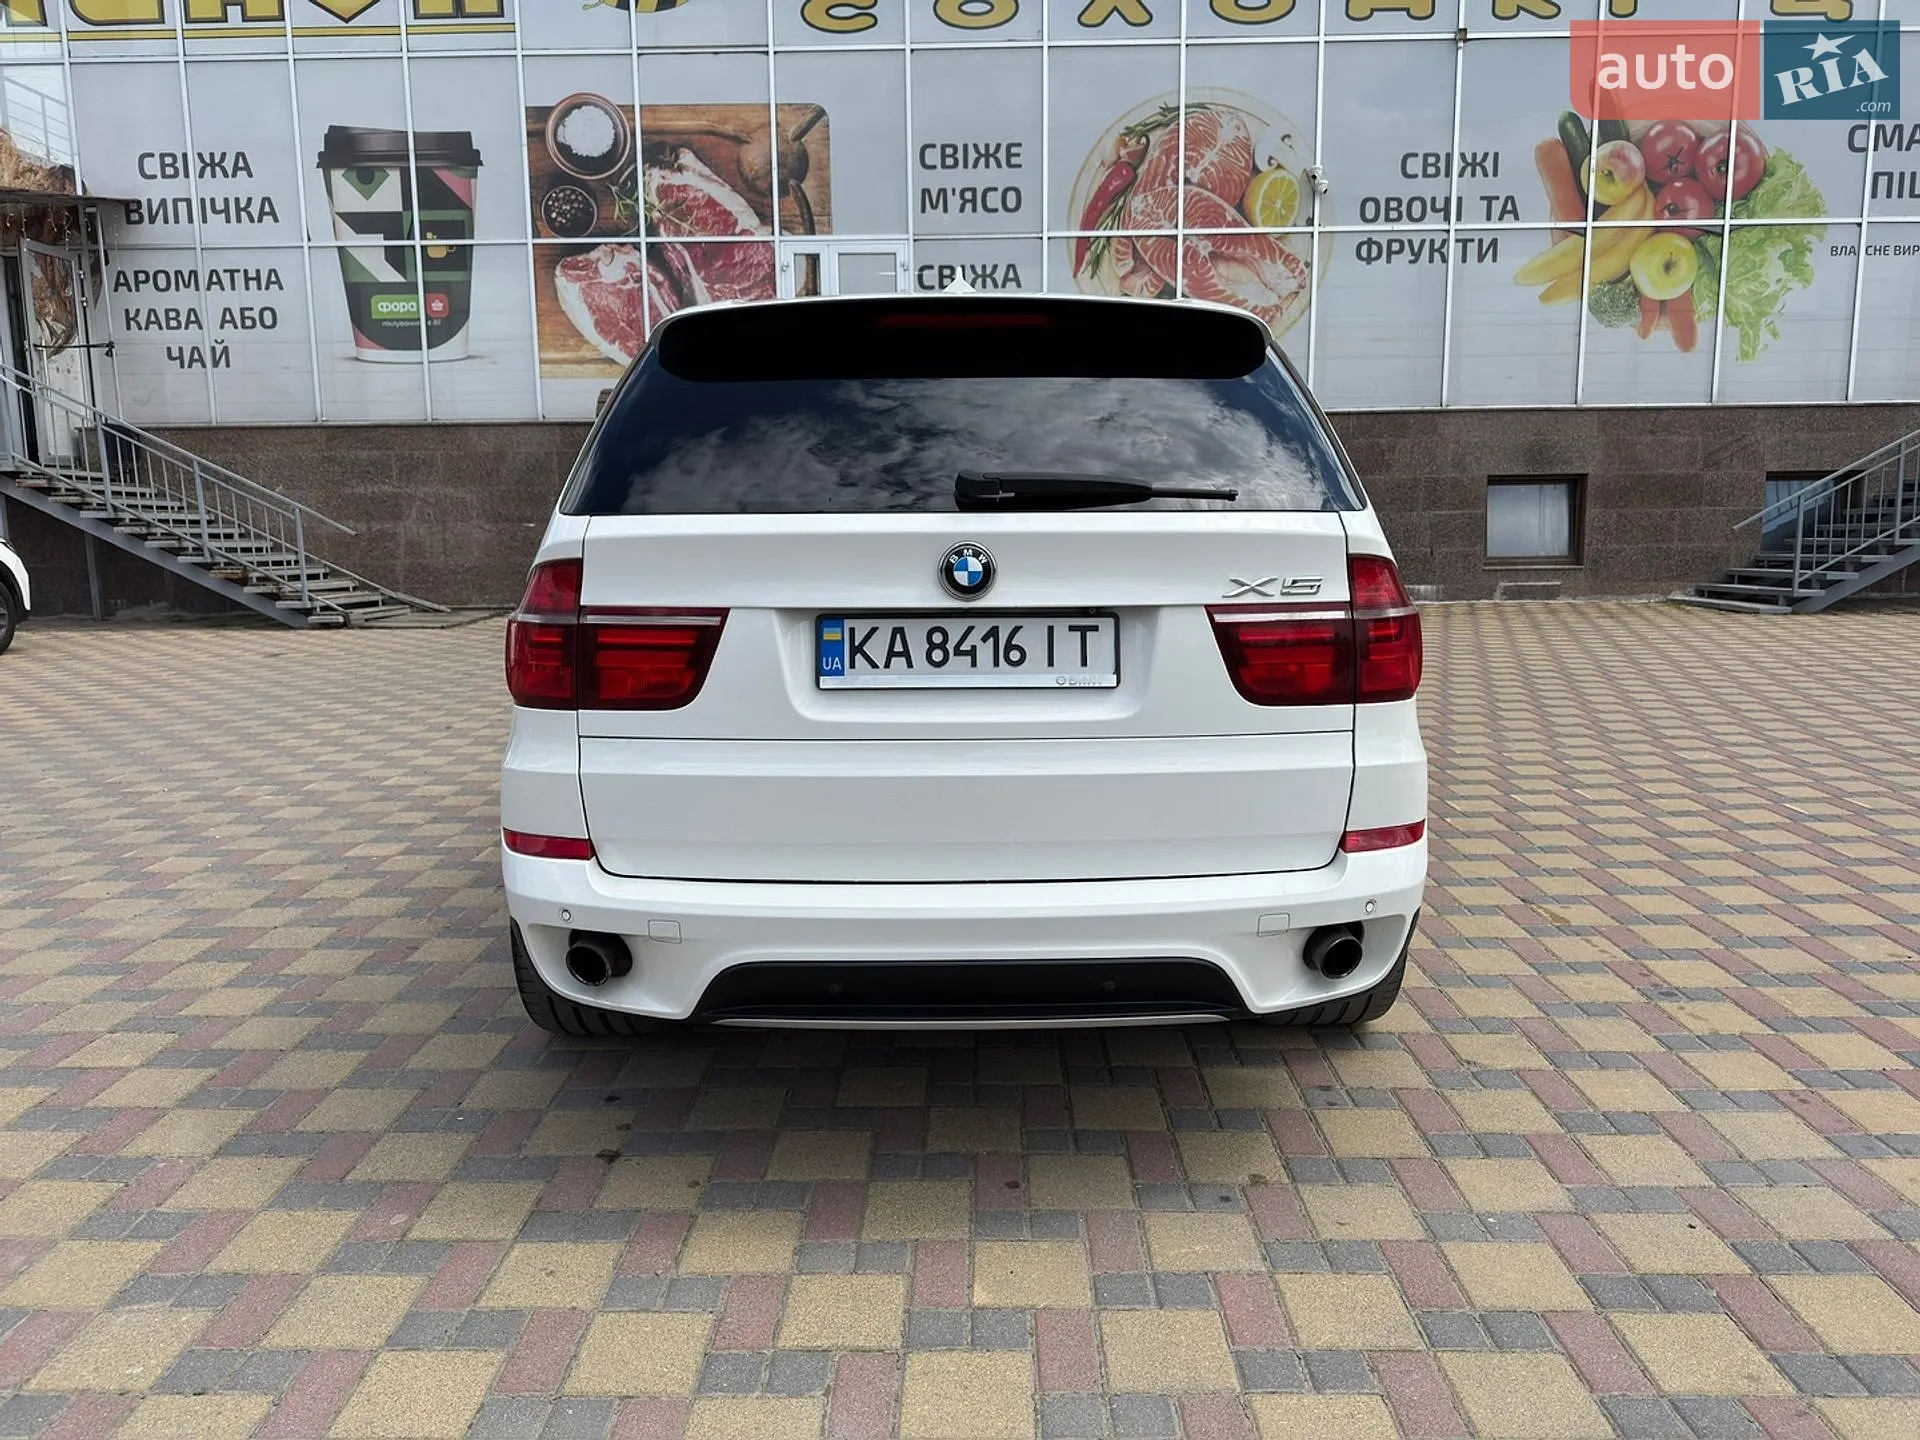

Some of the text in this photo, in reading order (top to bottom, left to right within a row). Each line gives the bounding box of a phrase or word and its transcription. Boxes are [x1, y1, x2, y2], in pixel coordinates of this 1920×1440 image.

[138, 151, 254, 180] СВІЖА
[919, 142, 1023, 170] СВІЖЕ
[1400, 151, 1500, 179] СВІЖІ
[124, 196, 280, 226] ВИПІЧКА
[920, 187, 1022, 214] М'ЯСО
[1359, 195, 1520, 223] ОВОЧІ ТА
[1355, 237, 1499, 266] ФРУКТИ
[113, 268, 284, 293] АРОМАТНА
[124, 306, 278, 331] КАВА АБО
[377, 301, 417, 314] фора
[166, 338, 231, 369] ЧАЙ
[1221, 575, 1324, 599] X5
[848, 626, 914, 670] KA
[925, 625, 1027, 669] 8416
[822, 656, 842, 671] UA
